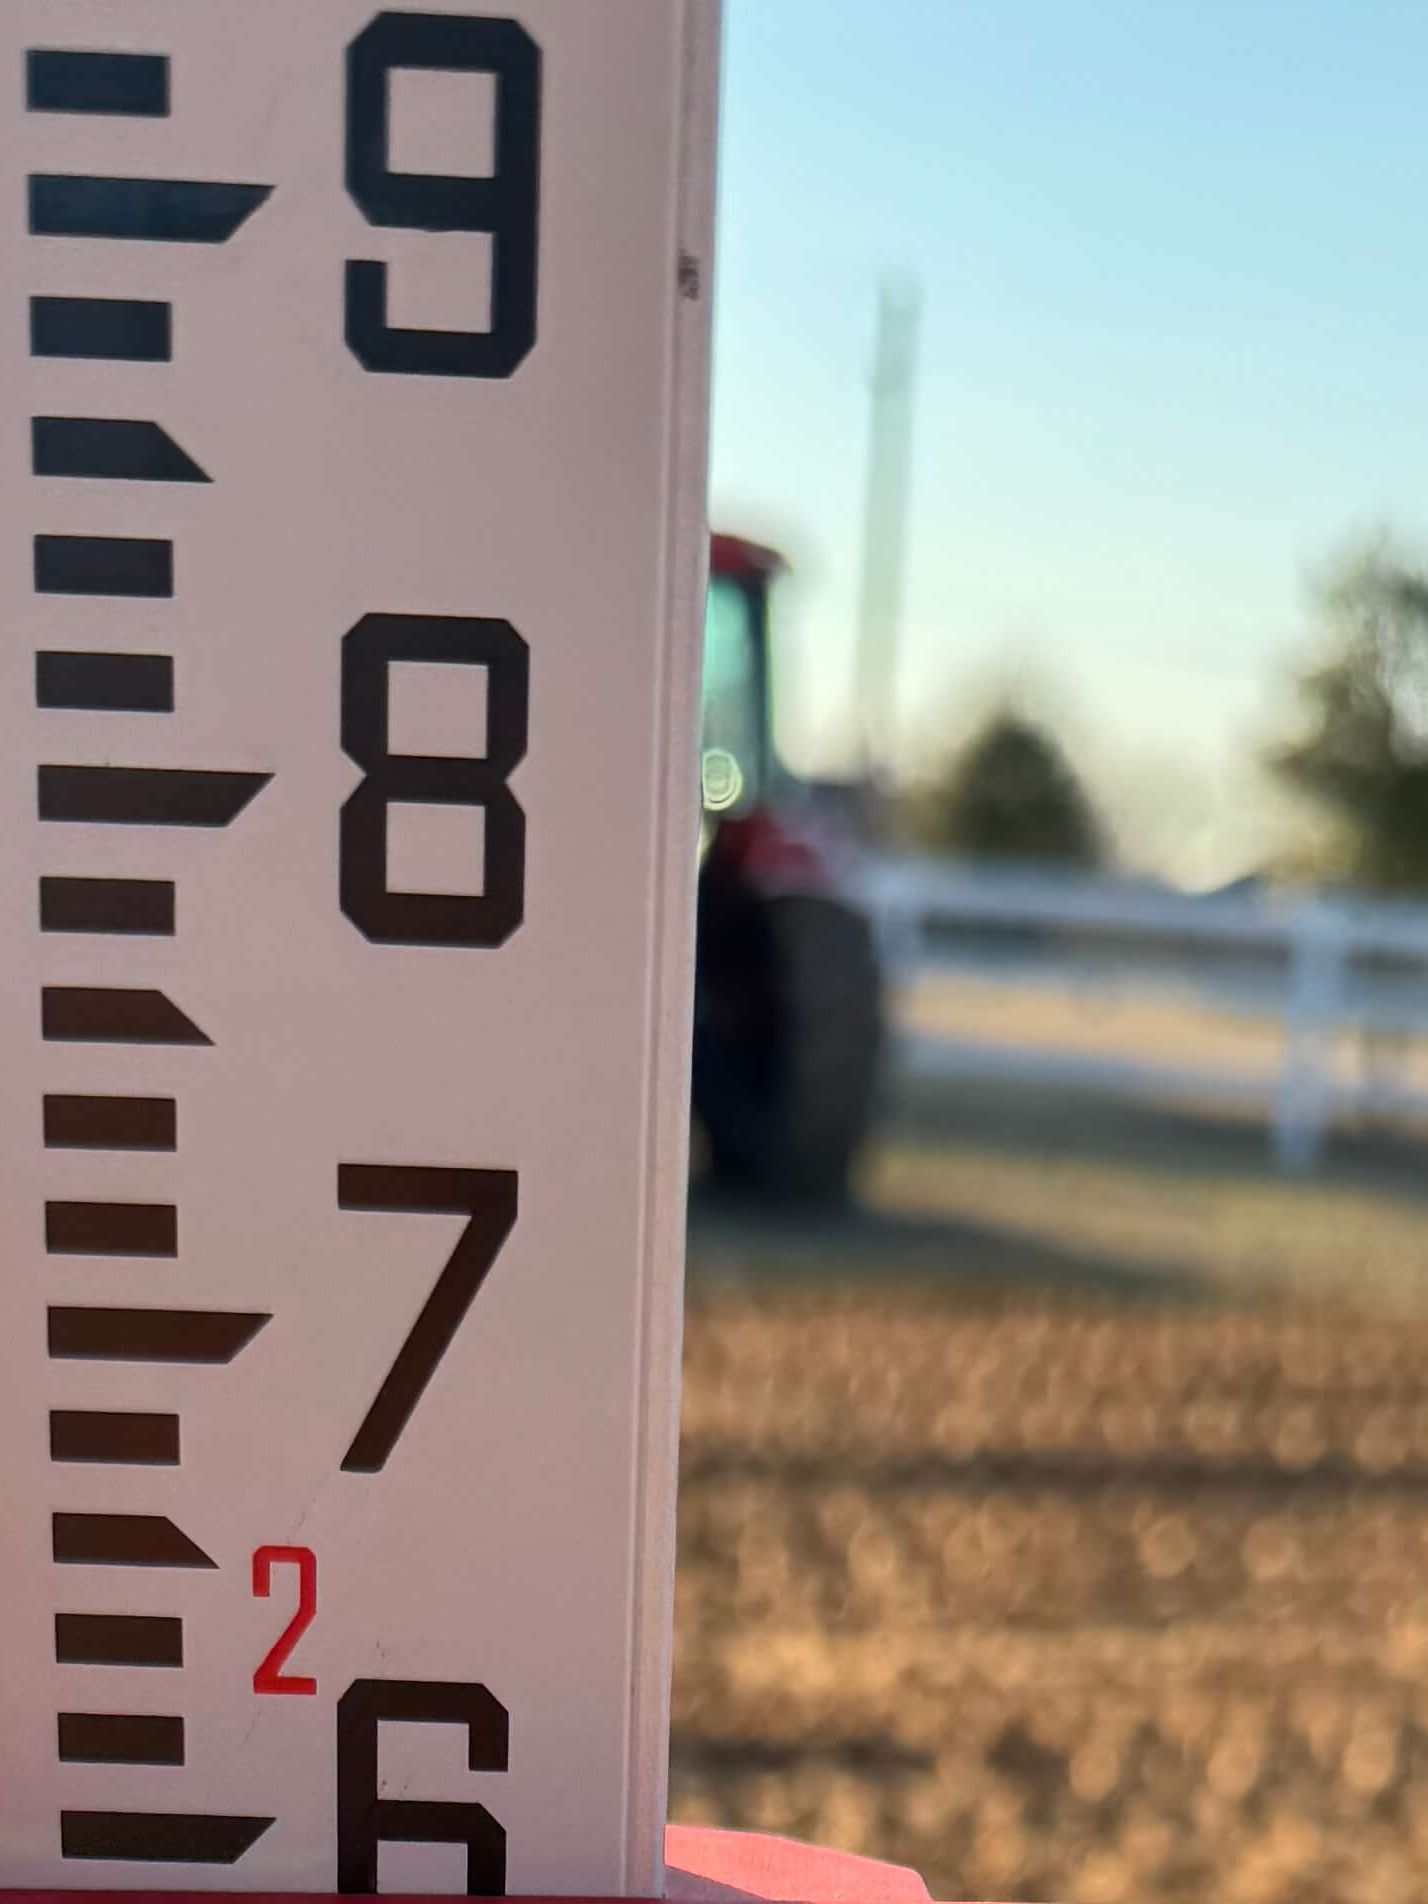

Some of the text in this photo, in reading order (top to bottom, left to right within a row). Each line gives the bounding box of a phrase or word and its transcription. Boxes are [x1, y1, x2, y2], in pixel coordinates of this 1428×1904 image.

[343, 9, 544, 380] 9
[338, 611, 531, 950] 8
[336, 1162, 519, 1474] 7
[250, 1544, 318, 1696] 2
[336, 1677, 510, 1894] 6
